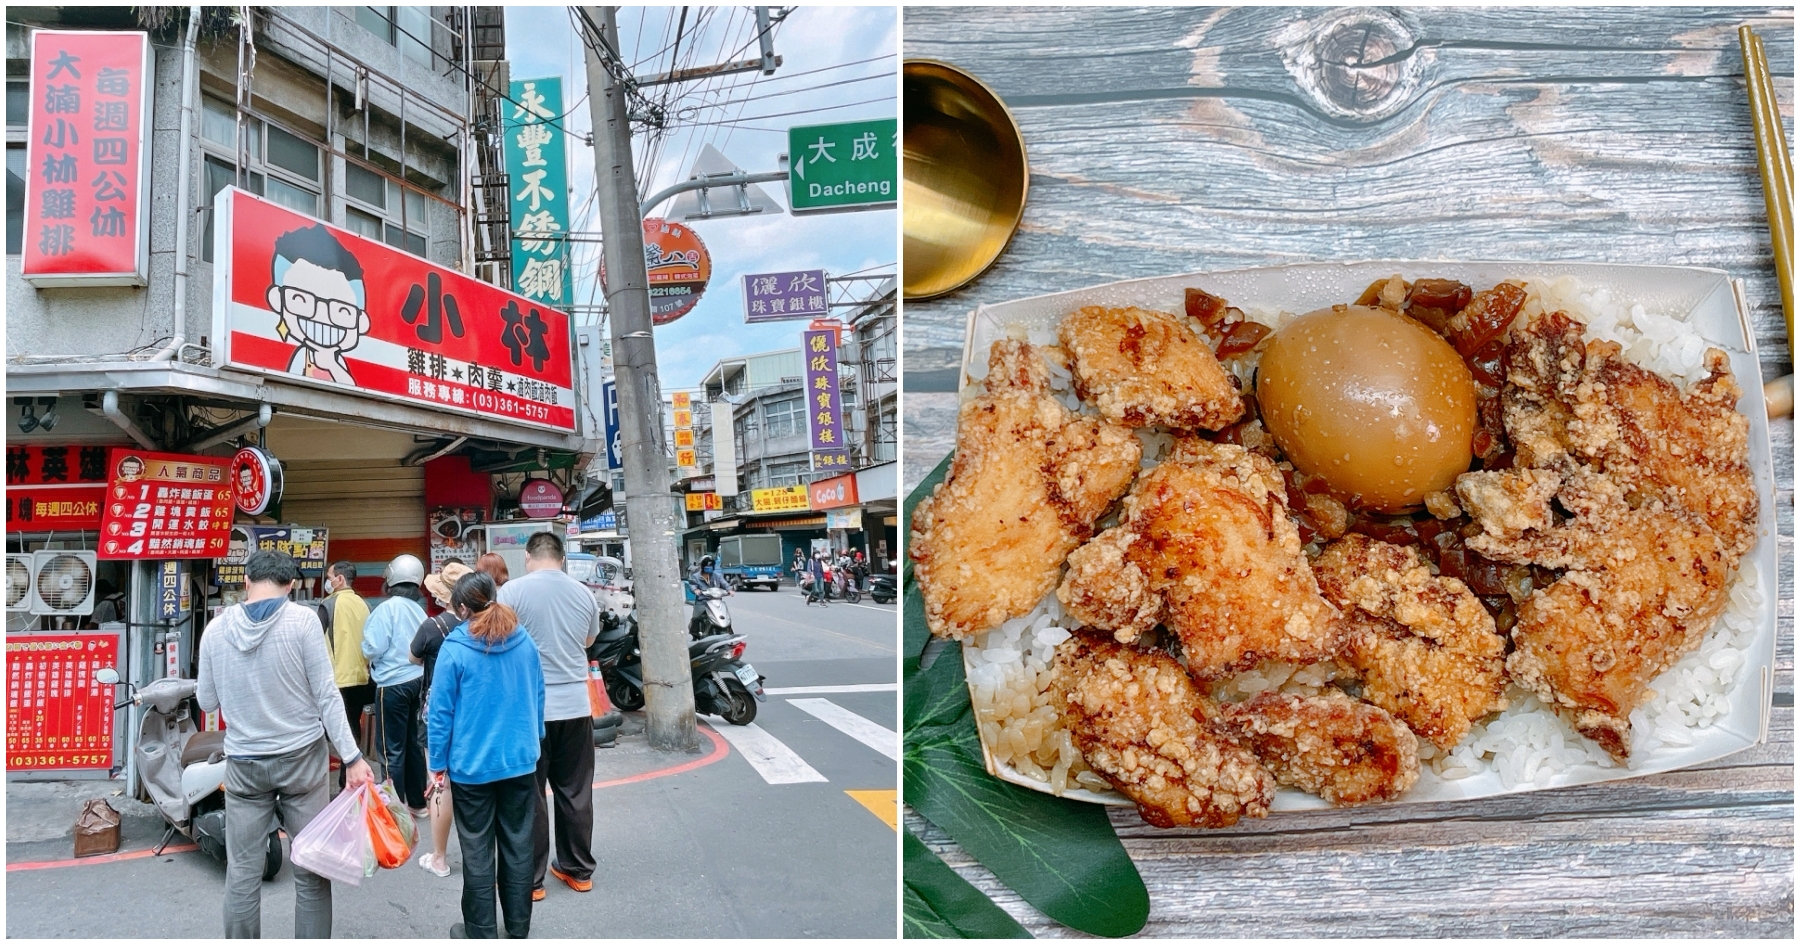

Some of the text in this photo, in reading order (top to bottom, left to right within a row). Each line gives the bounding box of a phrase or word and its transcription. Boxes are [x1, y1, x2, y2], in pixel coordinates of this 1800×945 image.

[39, 50, 81, 256] 大湳小林雞排
[90, 67, 130, 238] 每週四公休
[808, 132, 897, 165] 大成
[513, 82, 562, 301] 永豐不銹鋼
[809, 180, 891, 198] Dacheng
[660, 302, 674, 313] 107
[751, 295, 824, 314] 珠寶銀樓
[401, 271, 551, 373] 小林
[407, 346, 448, 381] 雞排
[467, 361, 503, 394] 肉羹
[158, 465, 220, 481] 人氣商品
[140, 484, 150, 500] 1
[217, 490, 232, 501] 65
[527, 494, 557, 502] foodpanda
[816, 488, 836, 503] CoCo
[35, 501, 98, 517] 每週四公休
[133, 503, 151, 519] 2
[215, 507, 229, 518] 65
[130, 521, 147, 537] 3
[127, 540, 144, 555] 4
[210, 538, 224, 549] 50
[163, 561, 177, 616] 週四公休
[10, 755, 108, 766] (03)361-5757
